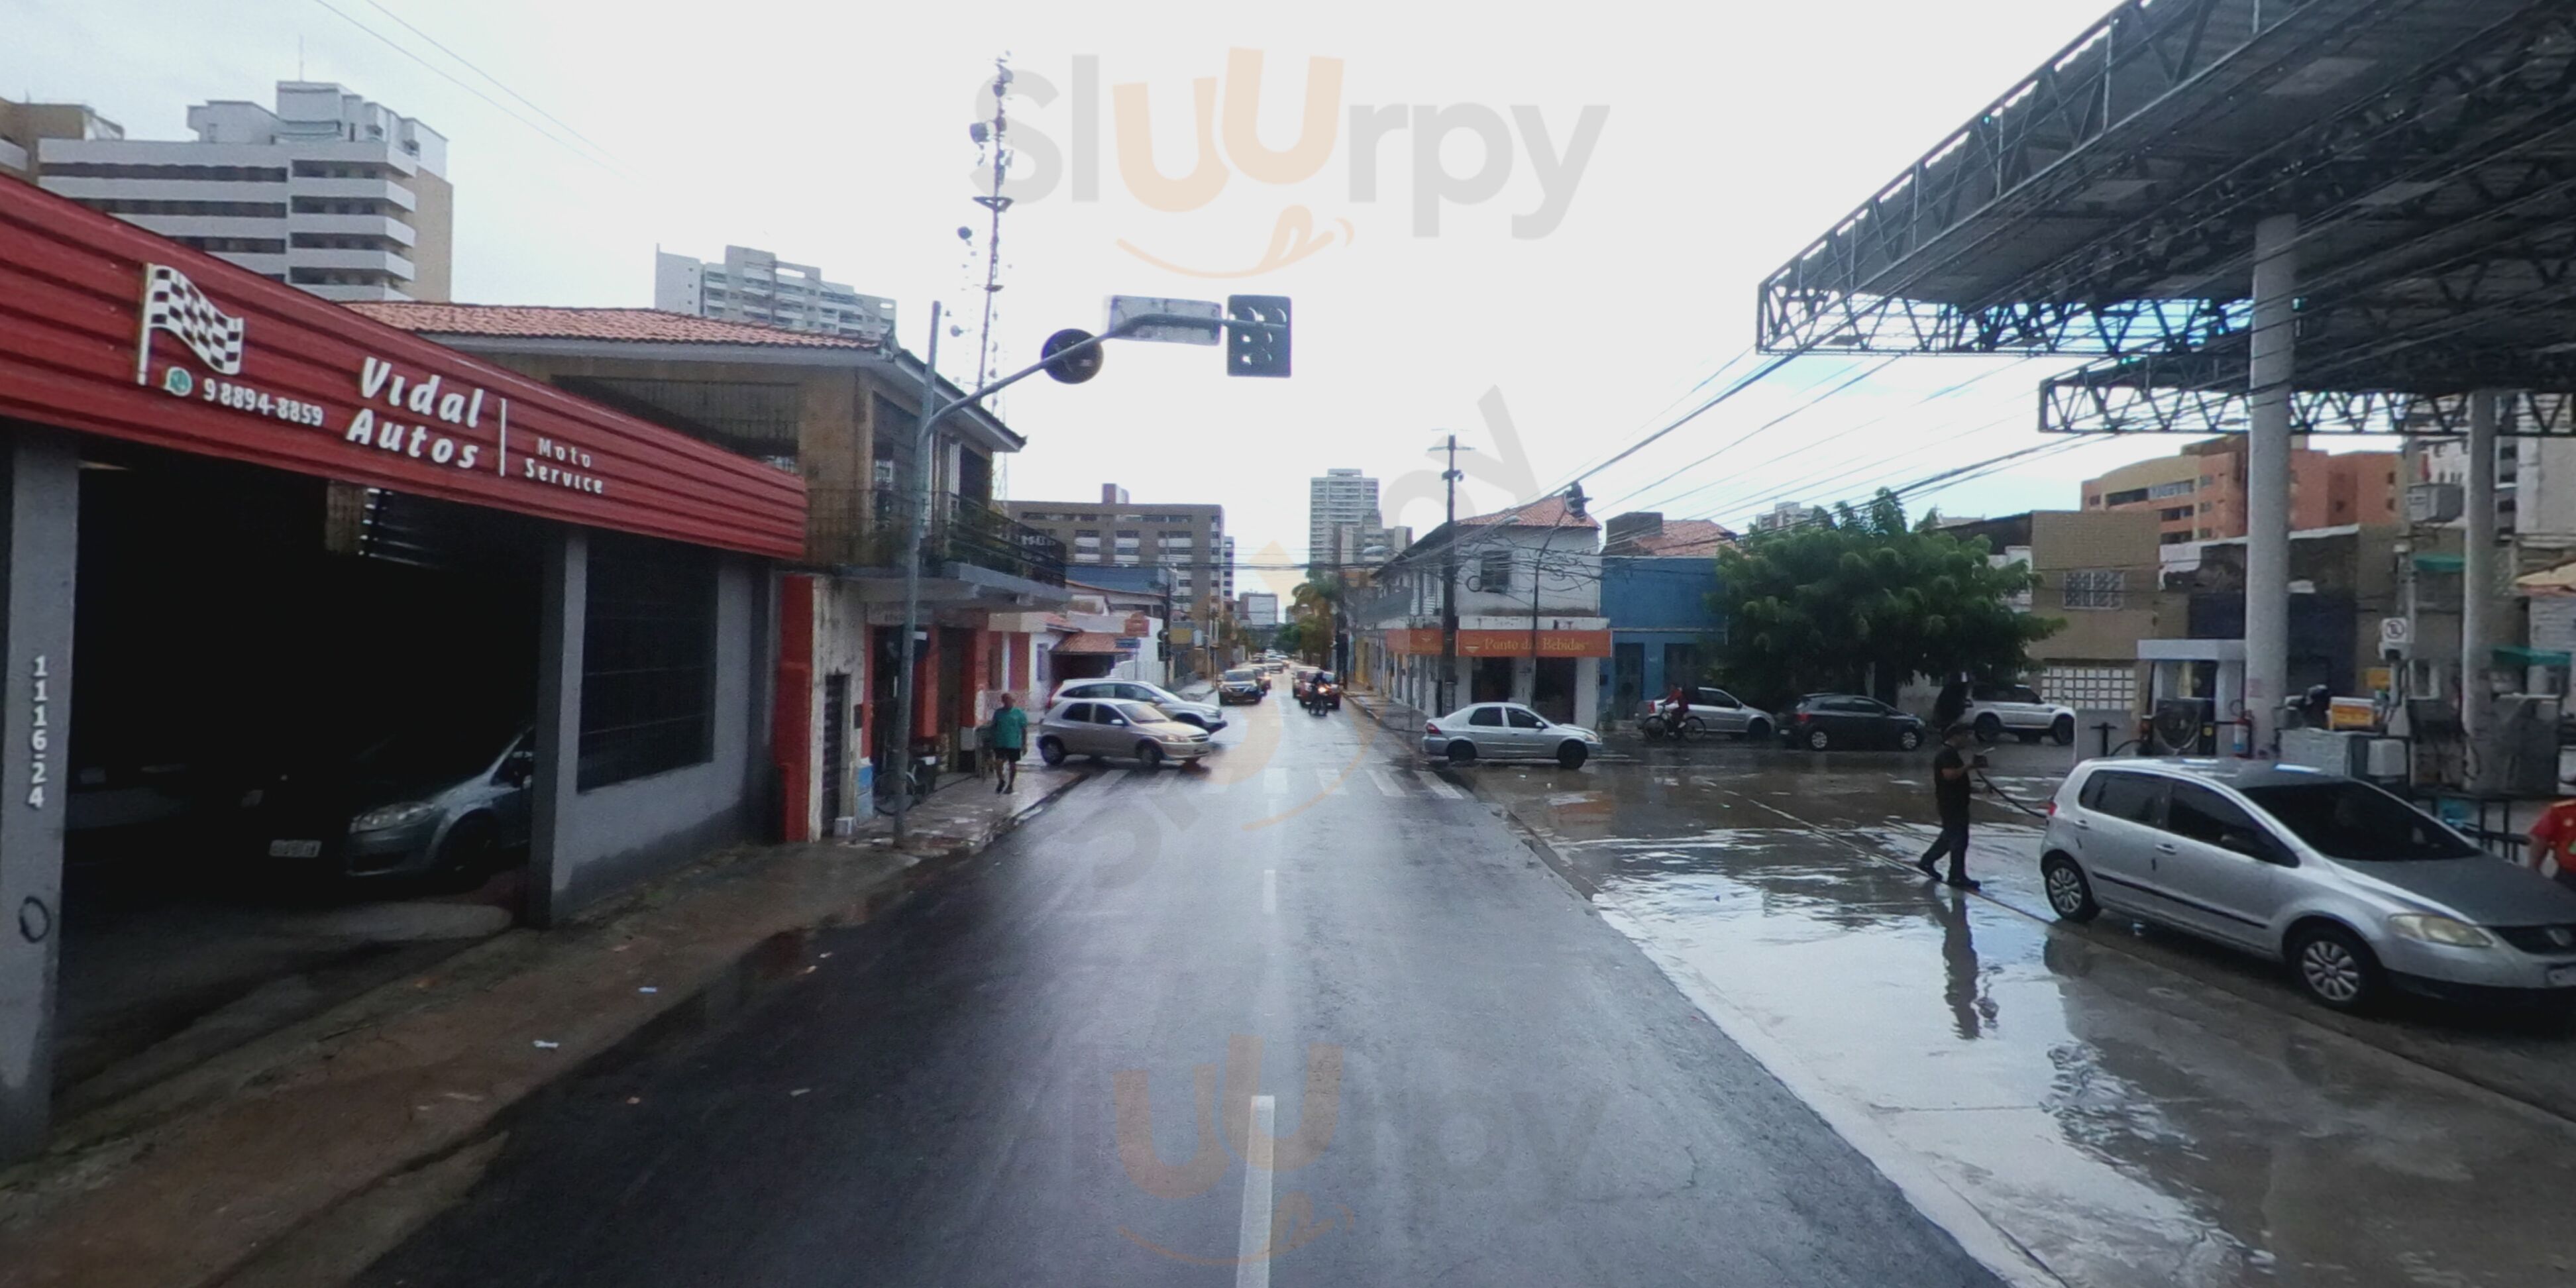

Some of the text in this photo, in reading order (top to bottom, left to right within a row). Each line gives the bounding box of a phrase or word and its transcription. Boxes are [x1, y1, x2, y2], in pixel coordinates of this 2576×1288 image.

[361, 356, 484, 428] Vidal
[345, 408, 479, 468] Autos
[537, 437, 591, 468] Moto
[525, 458, 603, 494] Service
[1542, 637, 1586, 651] Bebidas
